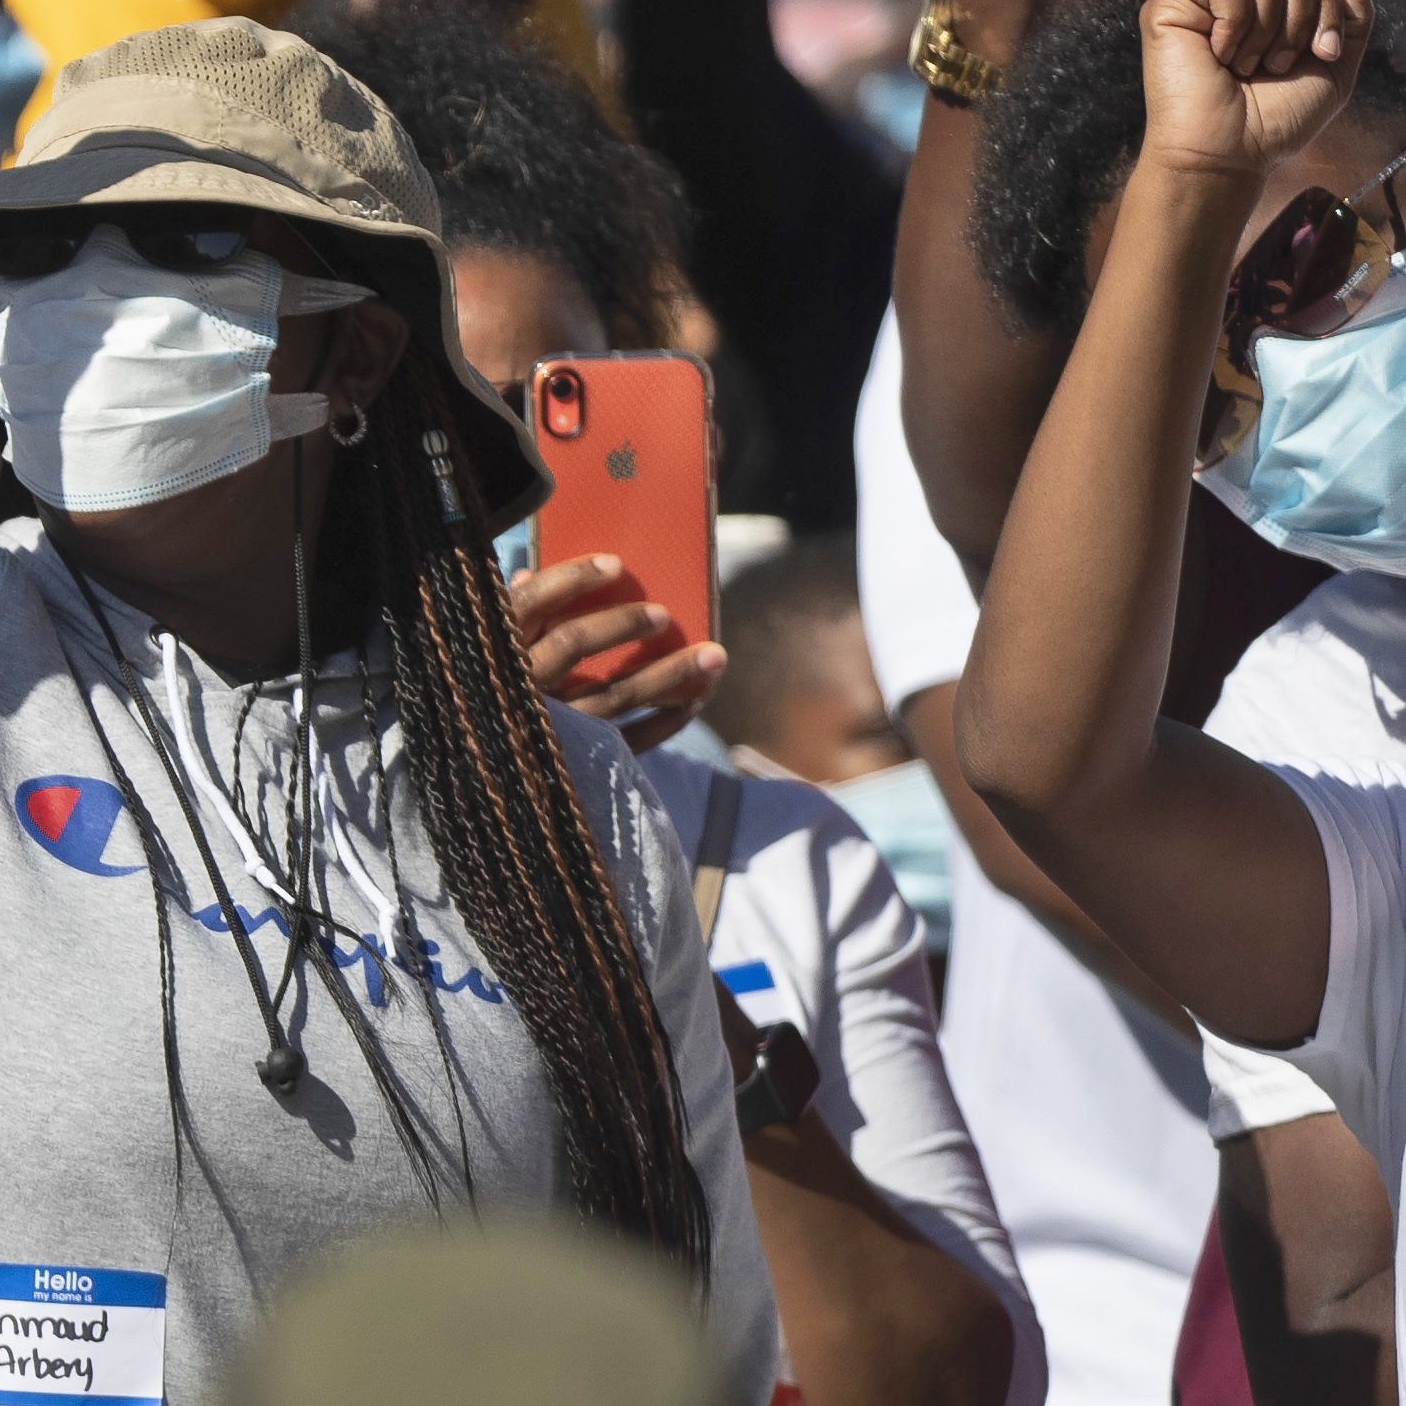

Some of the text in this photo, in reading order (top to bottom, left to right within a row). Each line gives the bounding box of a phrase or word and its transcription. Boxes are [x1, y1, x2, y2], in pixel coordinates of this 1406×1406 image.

[34, 1269, 93, 1292] Hello
[33, 1291, 93, 1303] my name is
